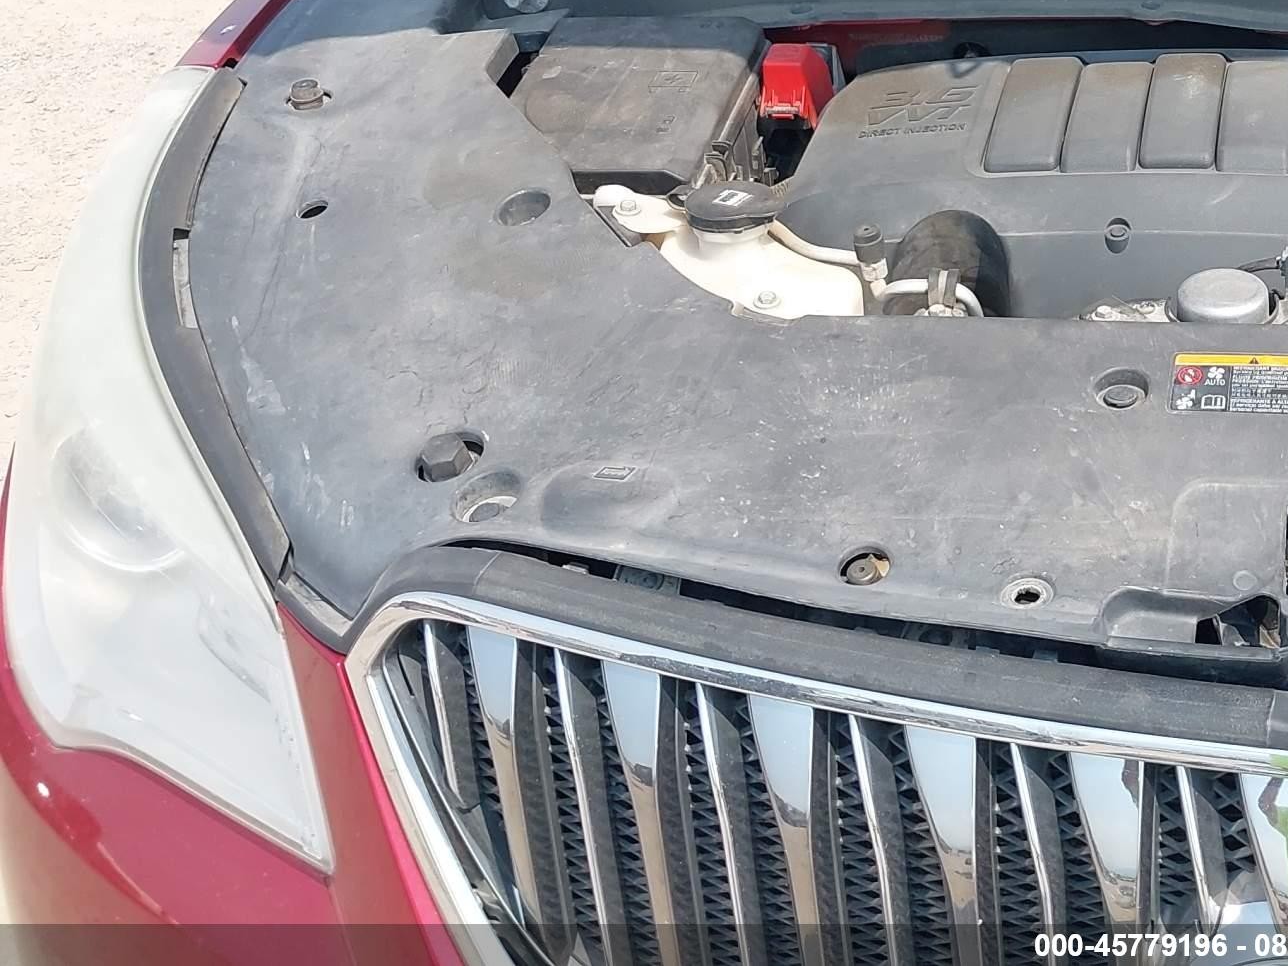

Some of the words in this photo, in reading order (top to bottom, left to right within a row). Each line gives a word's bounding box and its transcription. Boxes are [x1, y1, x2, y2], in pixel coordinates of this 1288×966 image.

[858, 127, 902, 139] DIRECT
[903, 122, 966, 135] INJECTION
[1204, 378, 1226, 386] AUTO
